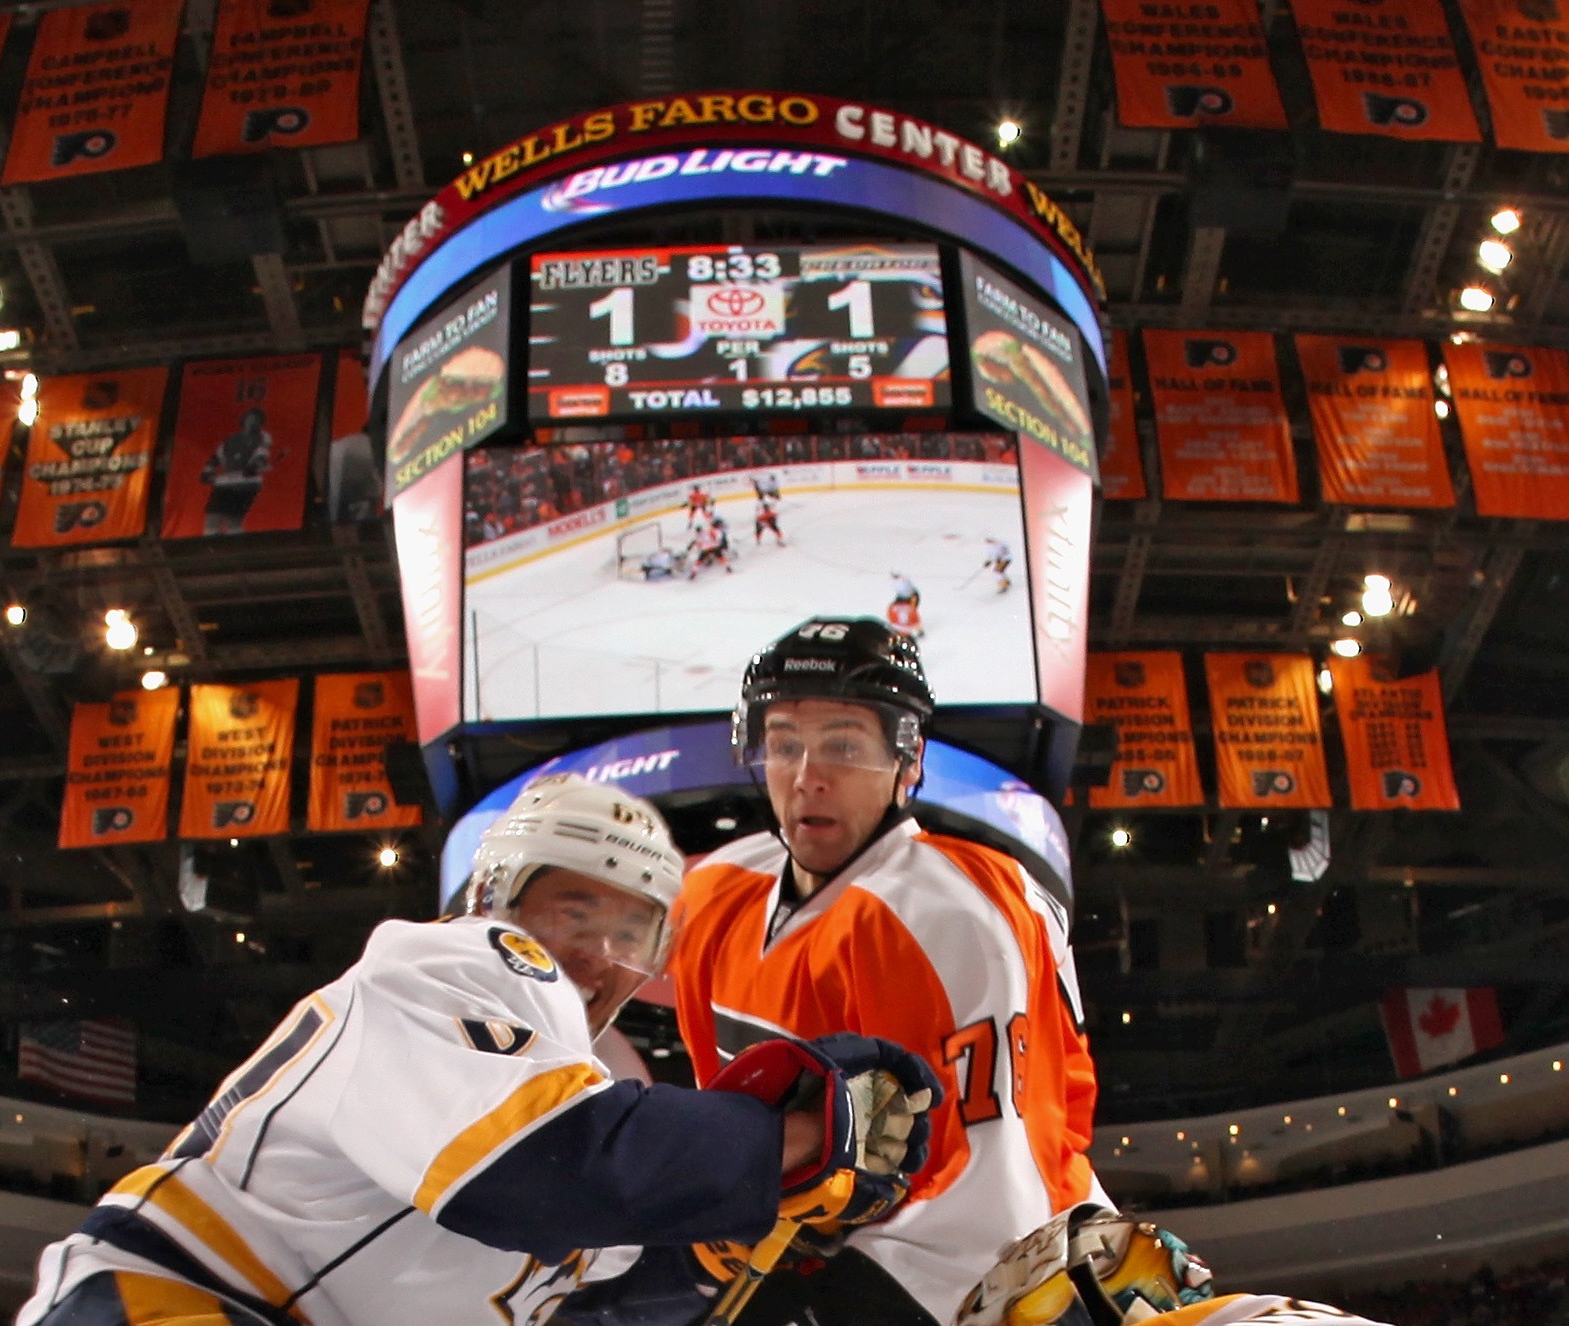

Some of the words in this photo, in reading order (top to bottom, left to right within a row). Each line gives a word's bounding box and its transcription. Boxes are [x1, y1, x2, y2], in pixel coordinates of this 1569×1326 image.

[454, 111, 616, 202] WELLS
[628, 95, 820, 137] FARGO
[835, 104, 1013, 198] CENTER
[560, 152, 690, 199] BUD
[687, 150, 848, 178] LIGHT
[539, 257, 660, 289] FLYERS
[688, 254, 780, 280] 8:33
[589, 287, 635, 347] 1
[828, 280, 875, 340] 1
[699, 318, 778, 333] TOYOTA
[588, 347, 648, 362] SHOTS
[717, 341, 760, 356] PER
[831, 340, 889, 355] SHOTS
[604, 362, 629, 387] 8
[728, 358, 749, 382] 1
[848, 355, 872, 380] 5
[1155, 377, 1199, 391] HALL
[1202, 378, 1226, 391] OF
[1356, 383, 1377, 396] OF
[629, 389, 720, 410] TOTAL
[1458, 388, 1501, 402] HALL
[1504, 390, 1524, 402] OF
[985, 387, 1058, 448] SECTION
[48, 416, 141, 440] STANLEY
[71, 437, 115, 457] CUP
[395, 425, 465, 489] SECTION
[467, 403, 499, 434] 104
[30, 452, 149, 481] CHAMPIONS
[783, 657, 837, 674] Reebok
[1096, 696, 1167, 710] PATRICK
[1227, 696, 1296, 710] PATRICK
[331, 716, 405, 731] PATRICK
[1227, 714, 1303, 727] DIVISION
[97, 734, 145, 749] WEST
[216, 726, 266, 743] WEST
[1120, 731, 1194, 744] MPIONS
[1216, 730, 1318, 745] CHAMPIONS
[82, 750, 156, 768] DIVISION
[201, 742, 276, 761] DIVISION
[68, 766, 170, 786] CHAMPIONS
[189, 757, 288, 777] CHAMPIONS
[604, 833, 663, 861] BAUER
